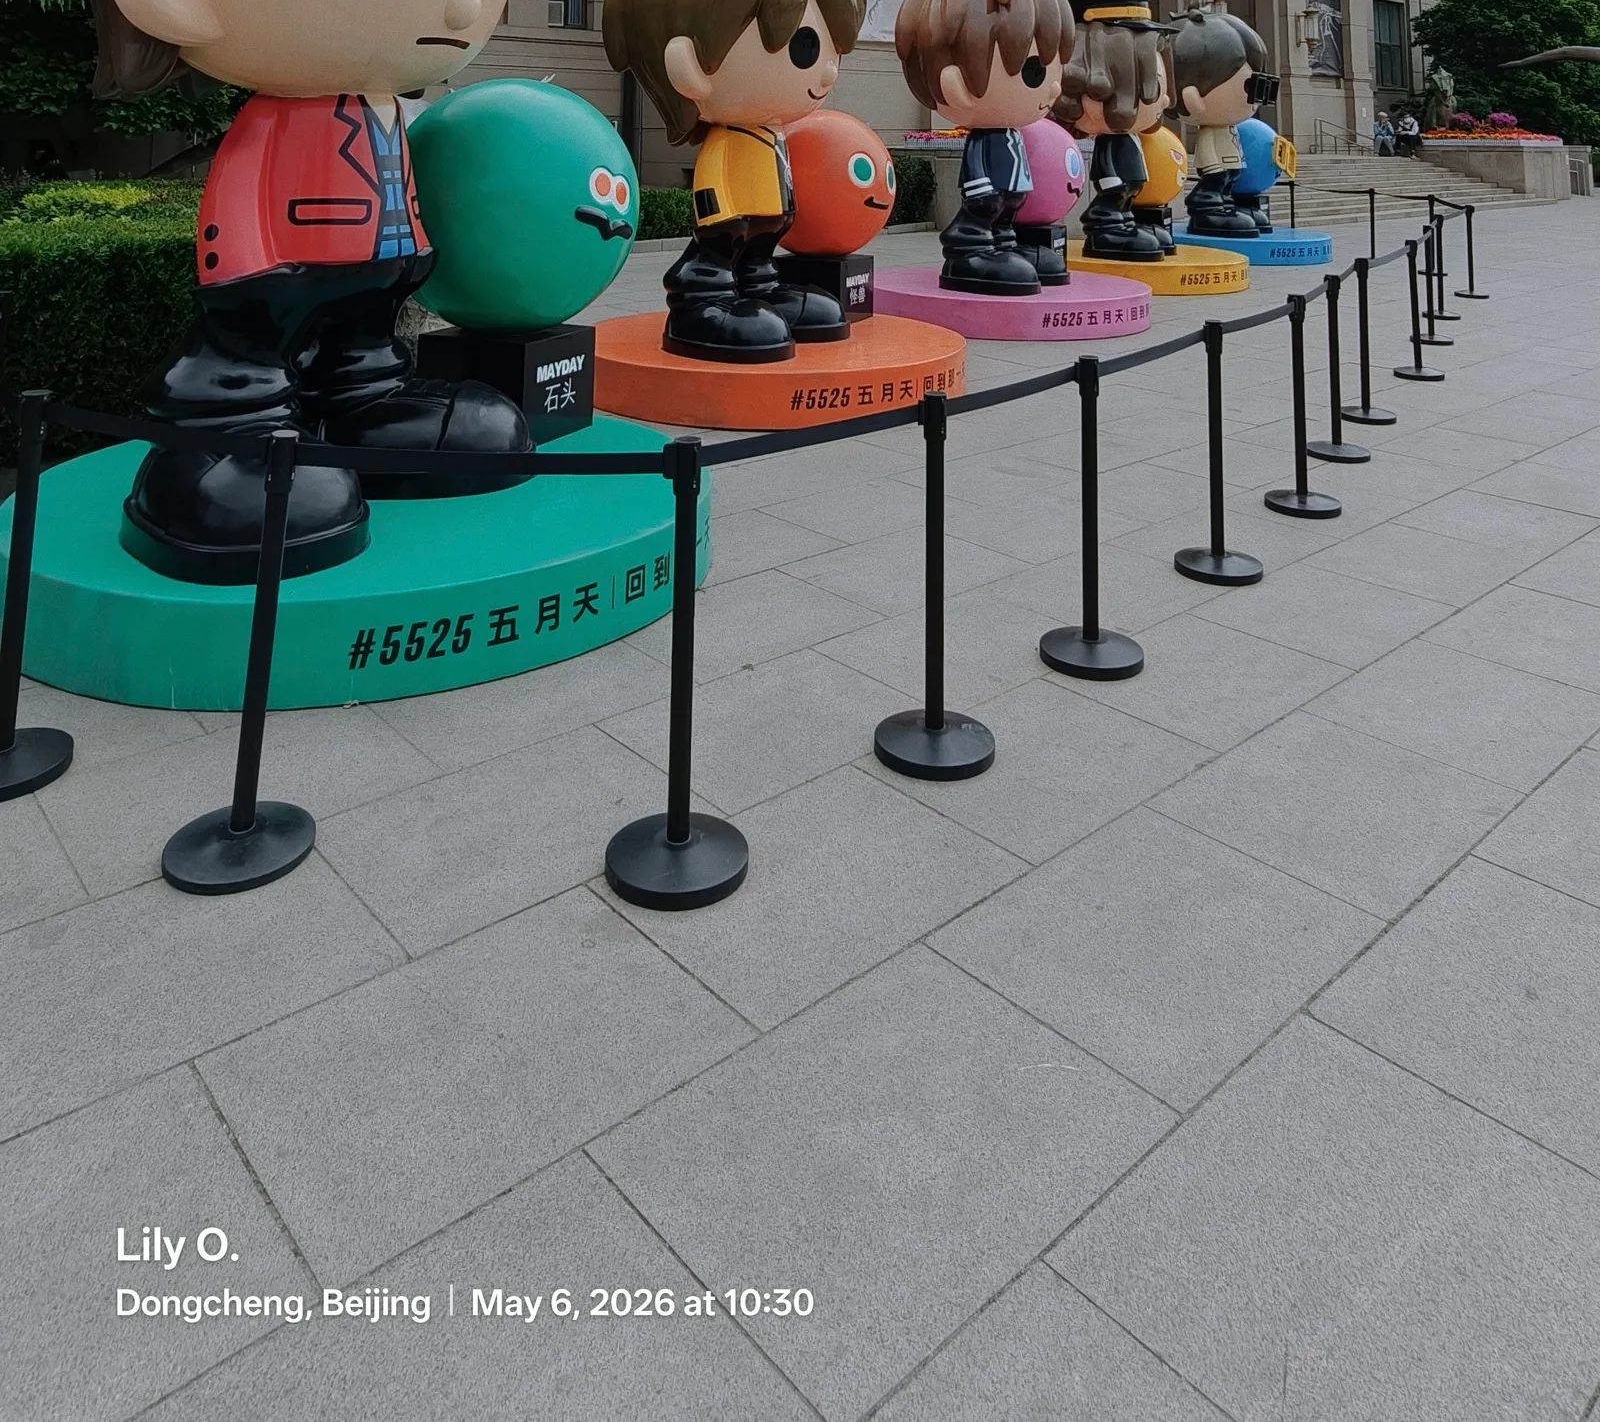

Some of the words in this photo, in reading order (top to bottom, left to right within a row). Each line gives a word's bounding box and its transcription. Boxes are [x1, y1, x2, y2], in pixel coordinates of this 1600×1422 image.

[1269, 247, 1296, 259] #5525
[1299, 246, 1319, 258] 五月天
[846, 272, 870, 288] MAYDAY
[1180, 273, 1210, 286] #5525
[1213, 270, 1237, 284] 五月天
[1042, 311, 1083, 328] #5525
[1087, 309, 1124, 326] 五月天
[536, 354, 586, 384] MAYDAY
[544, 378, 576, 414] 石头
[790, 387, 851, 411] #5525
[857, 379, 914, 406] 五月天
[348, 613, 475, 671] #5525
[486, 581, 600, 647] 五月天
